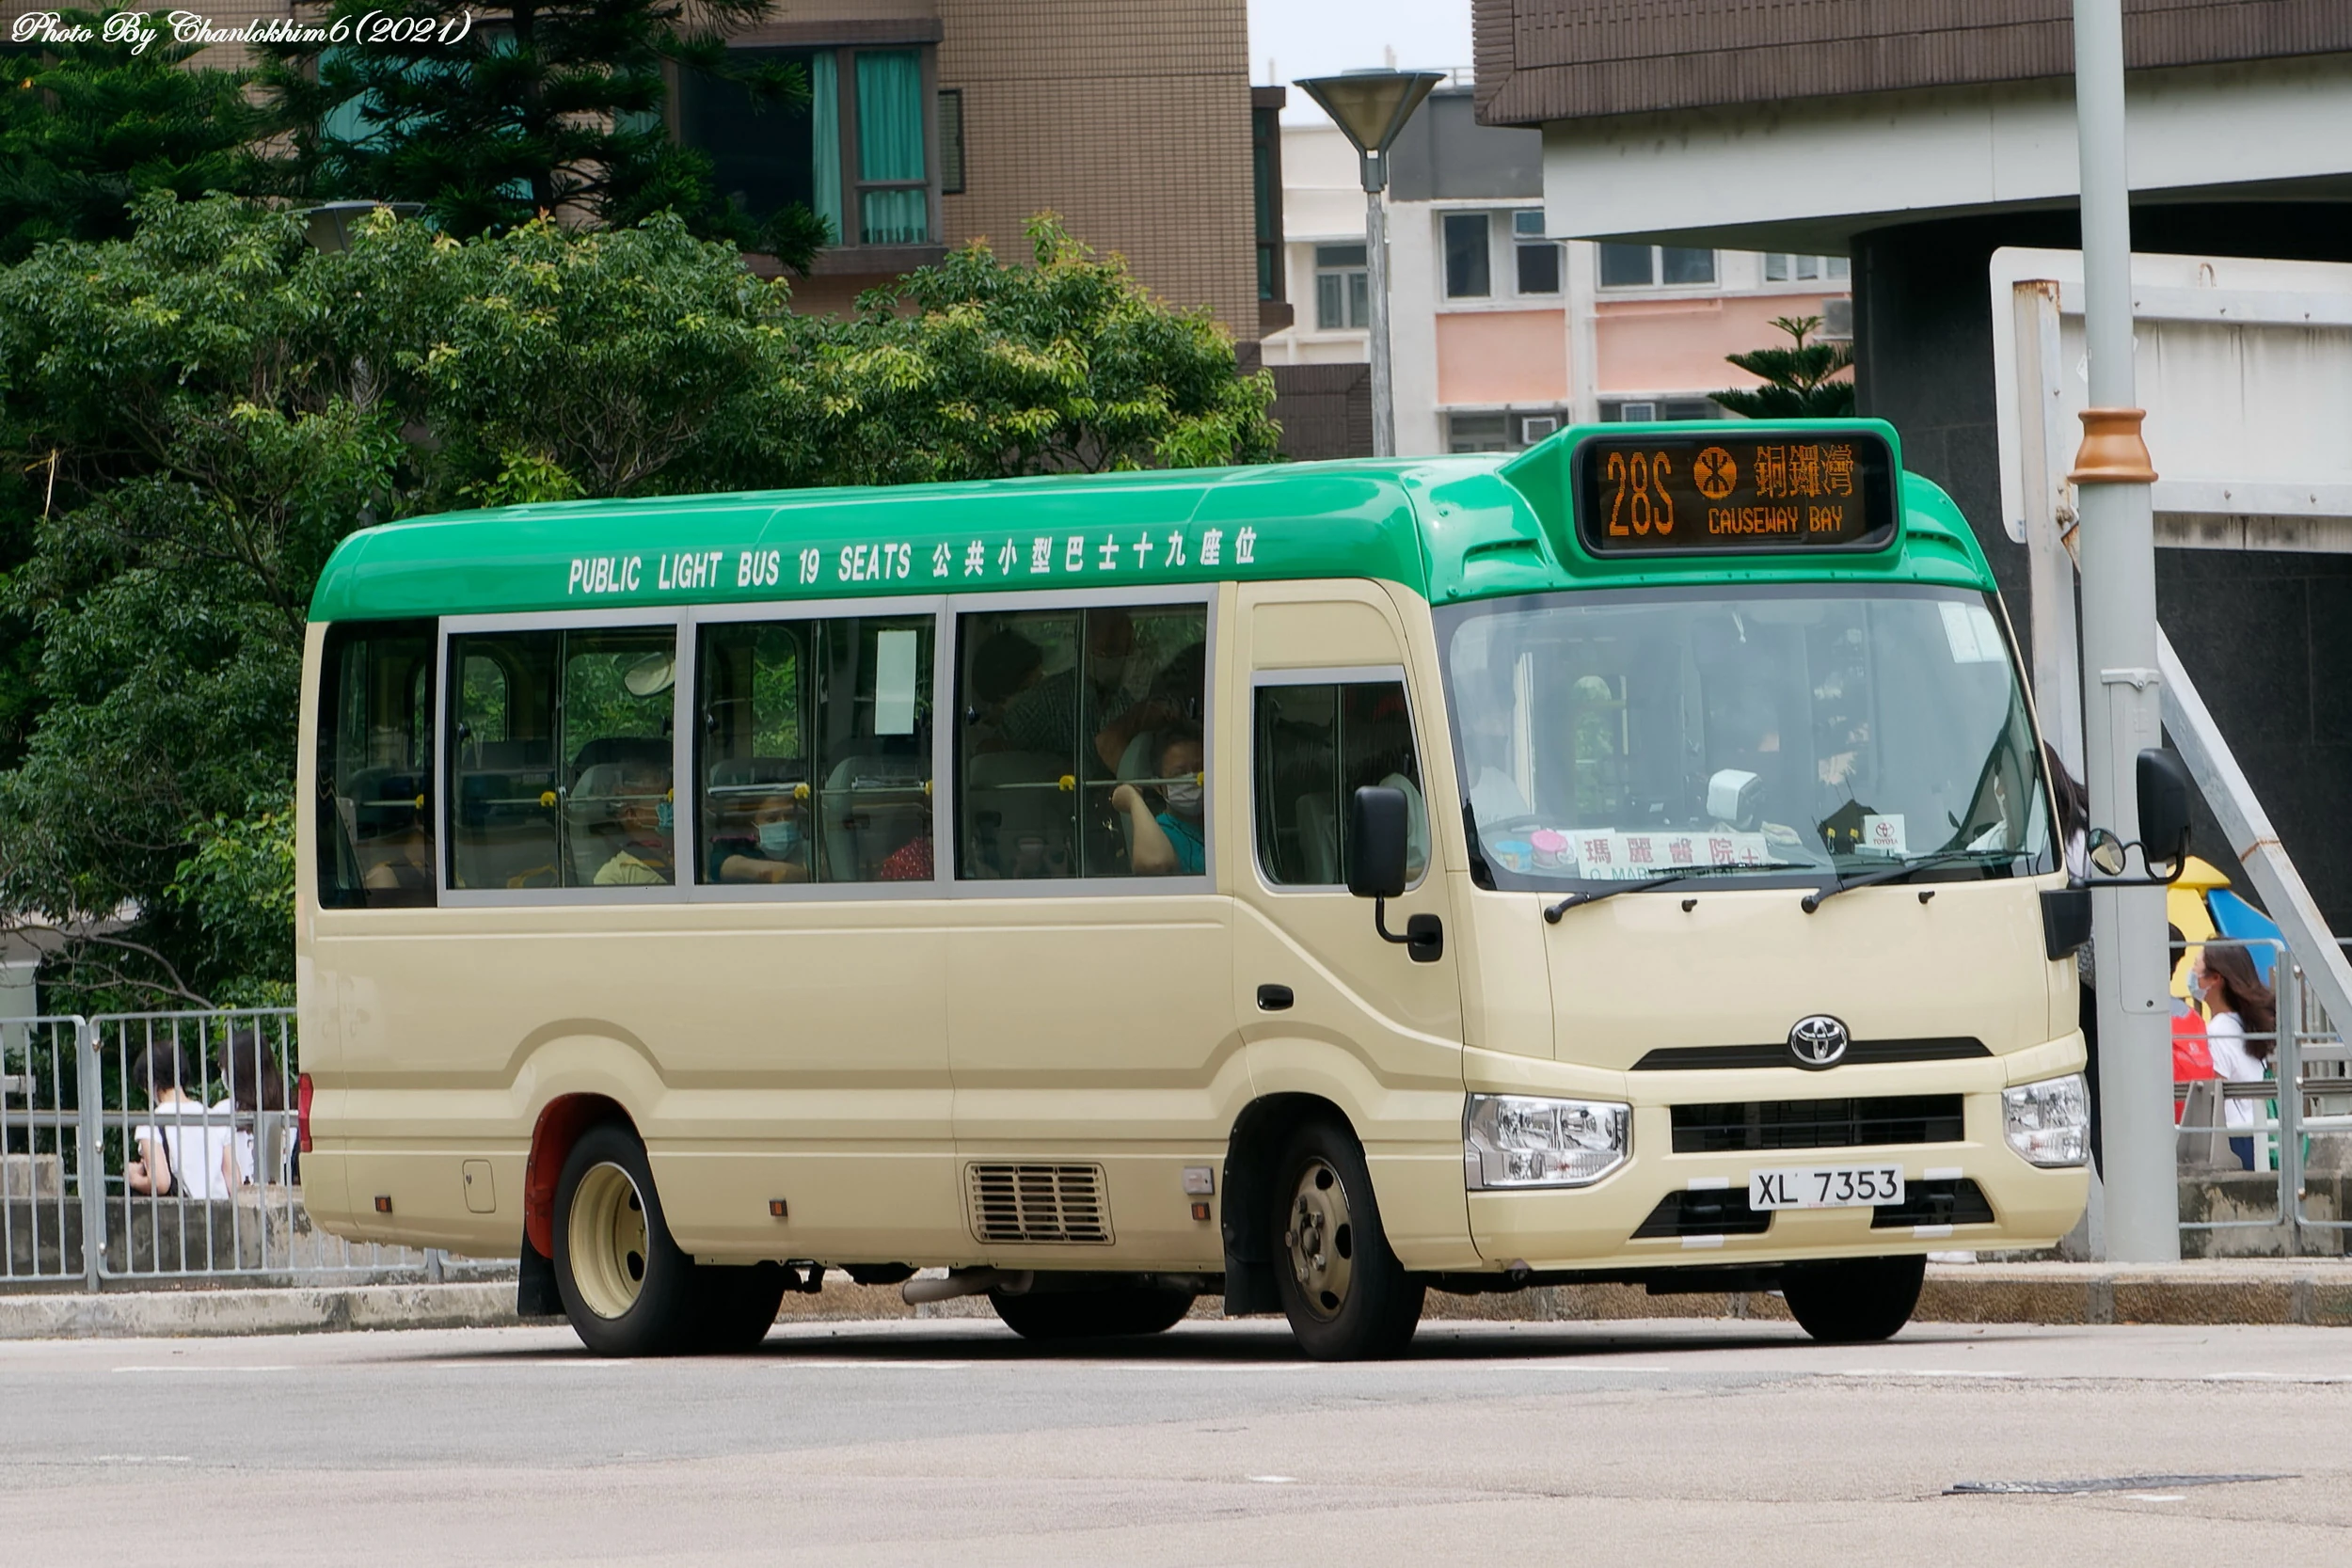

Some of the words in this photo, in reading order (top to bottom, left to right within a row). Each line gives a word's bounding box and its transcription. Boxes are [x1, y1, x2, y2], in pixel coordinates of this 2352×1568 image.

[1607, 451, 1675, 536] 28S
[1753, 443, 1854, 499] 銅鑼灣
[1707, 505, 1799, 534] CAUSEWAY
[1808, 504, 1844, 532] BAY
[568, 555, 642, 594] PUBLIC
[658, 551, 723, 591] LIGHT
[737, 549, 781, 588] BUS
[799, 547, 820, 585] 19
[837, 542, 913, 582] SEATS
[931, 526, 1258, 579] 公共小型巴士十九座位
[1757, 1174, 1799, 1205] XL
[1813, 1169, 1898, 1203] 7353
